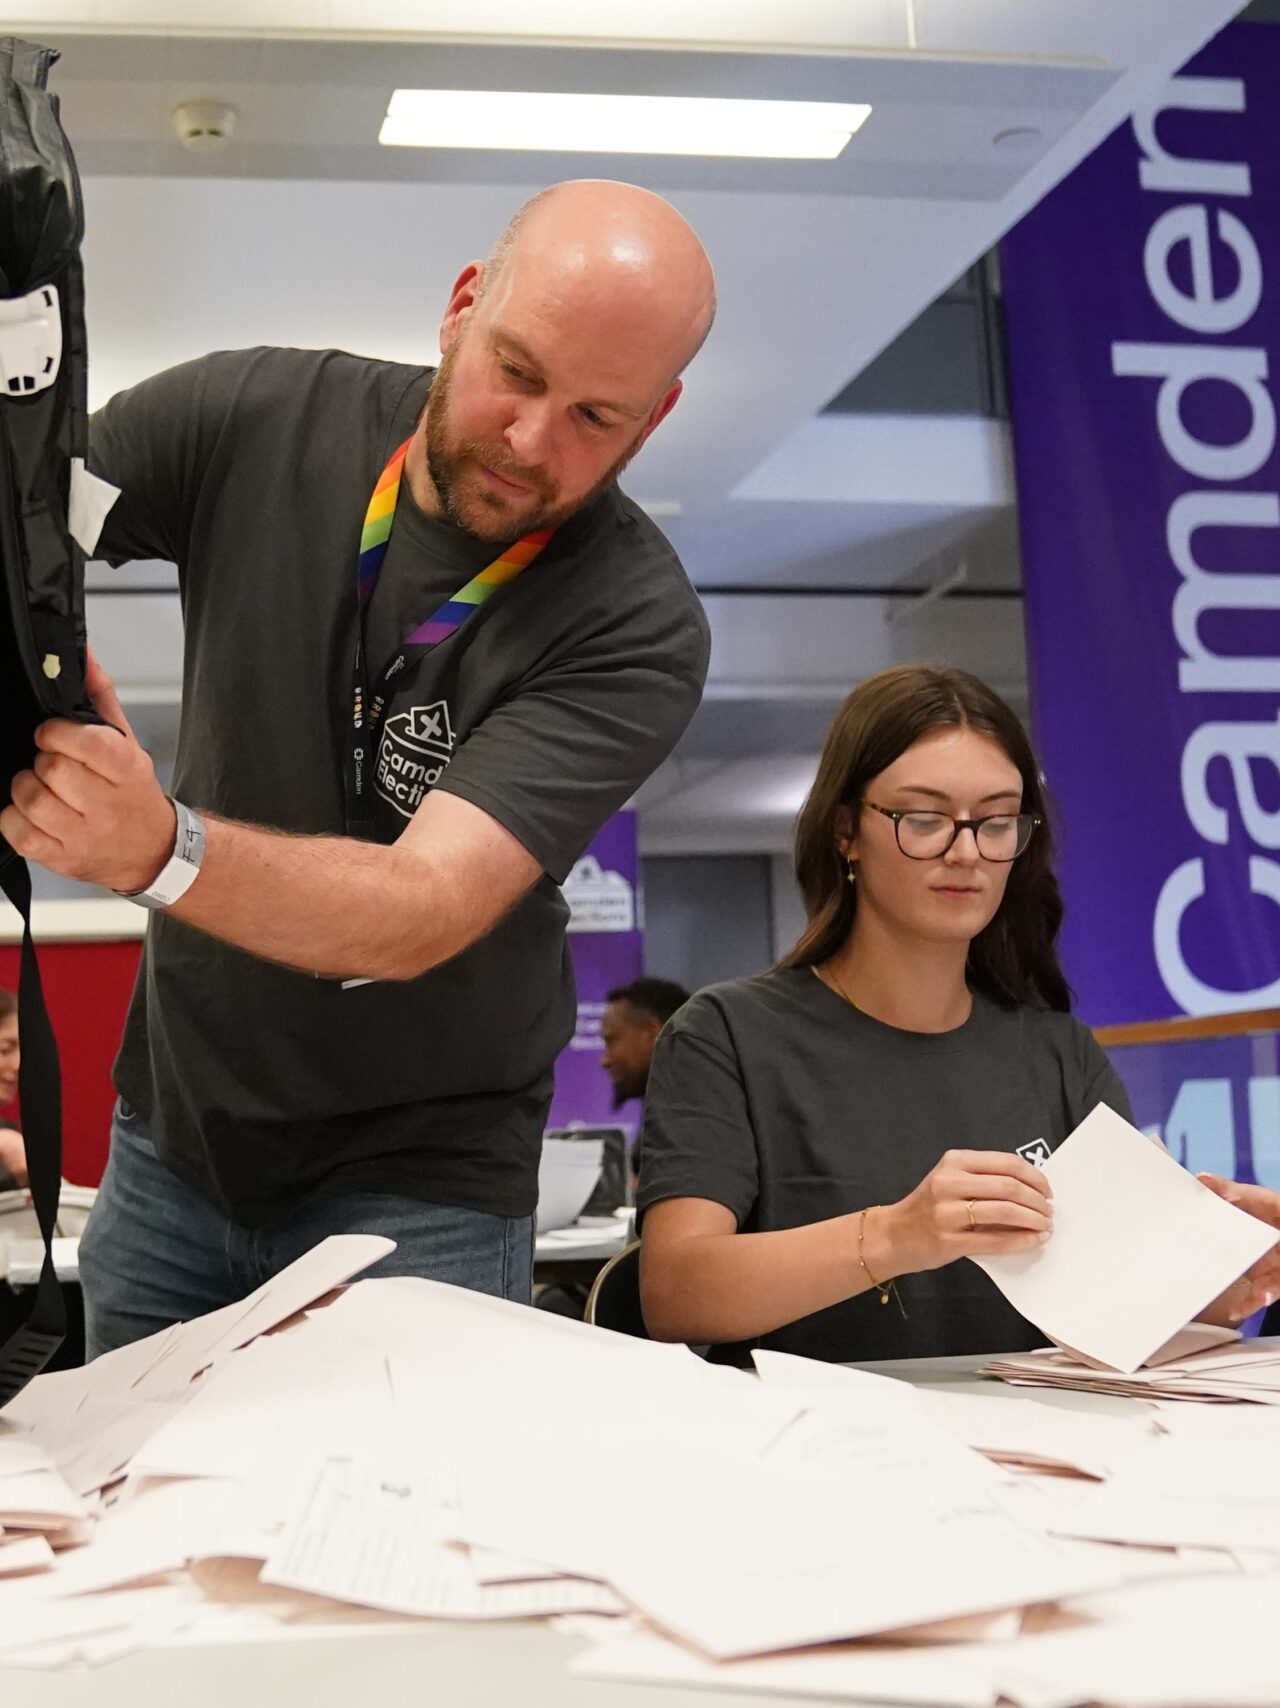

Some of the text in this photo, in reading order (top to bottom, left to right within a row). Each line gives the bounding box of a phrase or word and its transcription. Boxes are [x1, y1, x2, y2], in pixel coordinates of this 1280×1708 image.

[1111, 75, 1280, 1017] Camden
[355, 761, 363, 795] Camden
[377, 759, 425, 806] Electi
[382, 739, 448, 786] Camd
